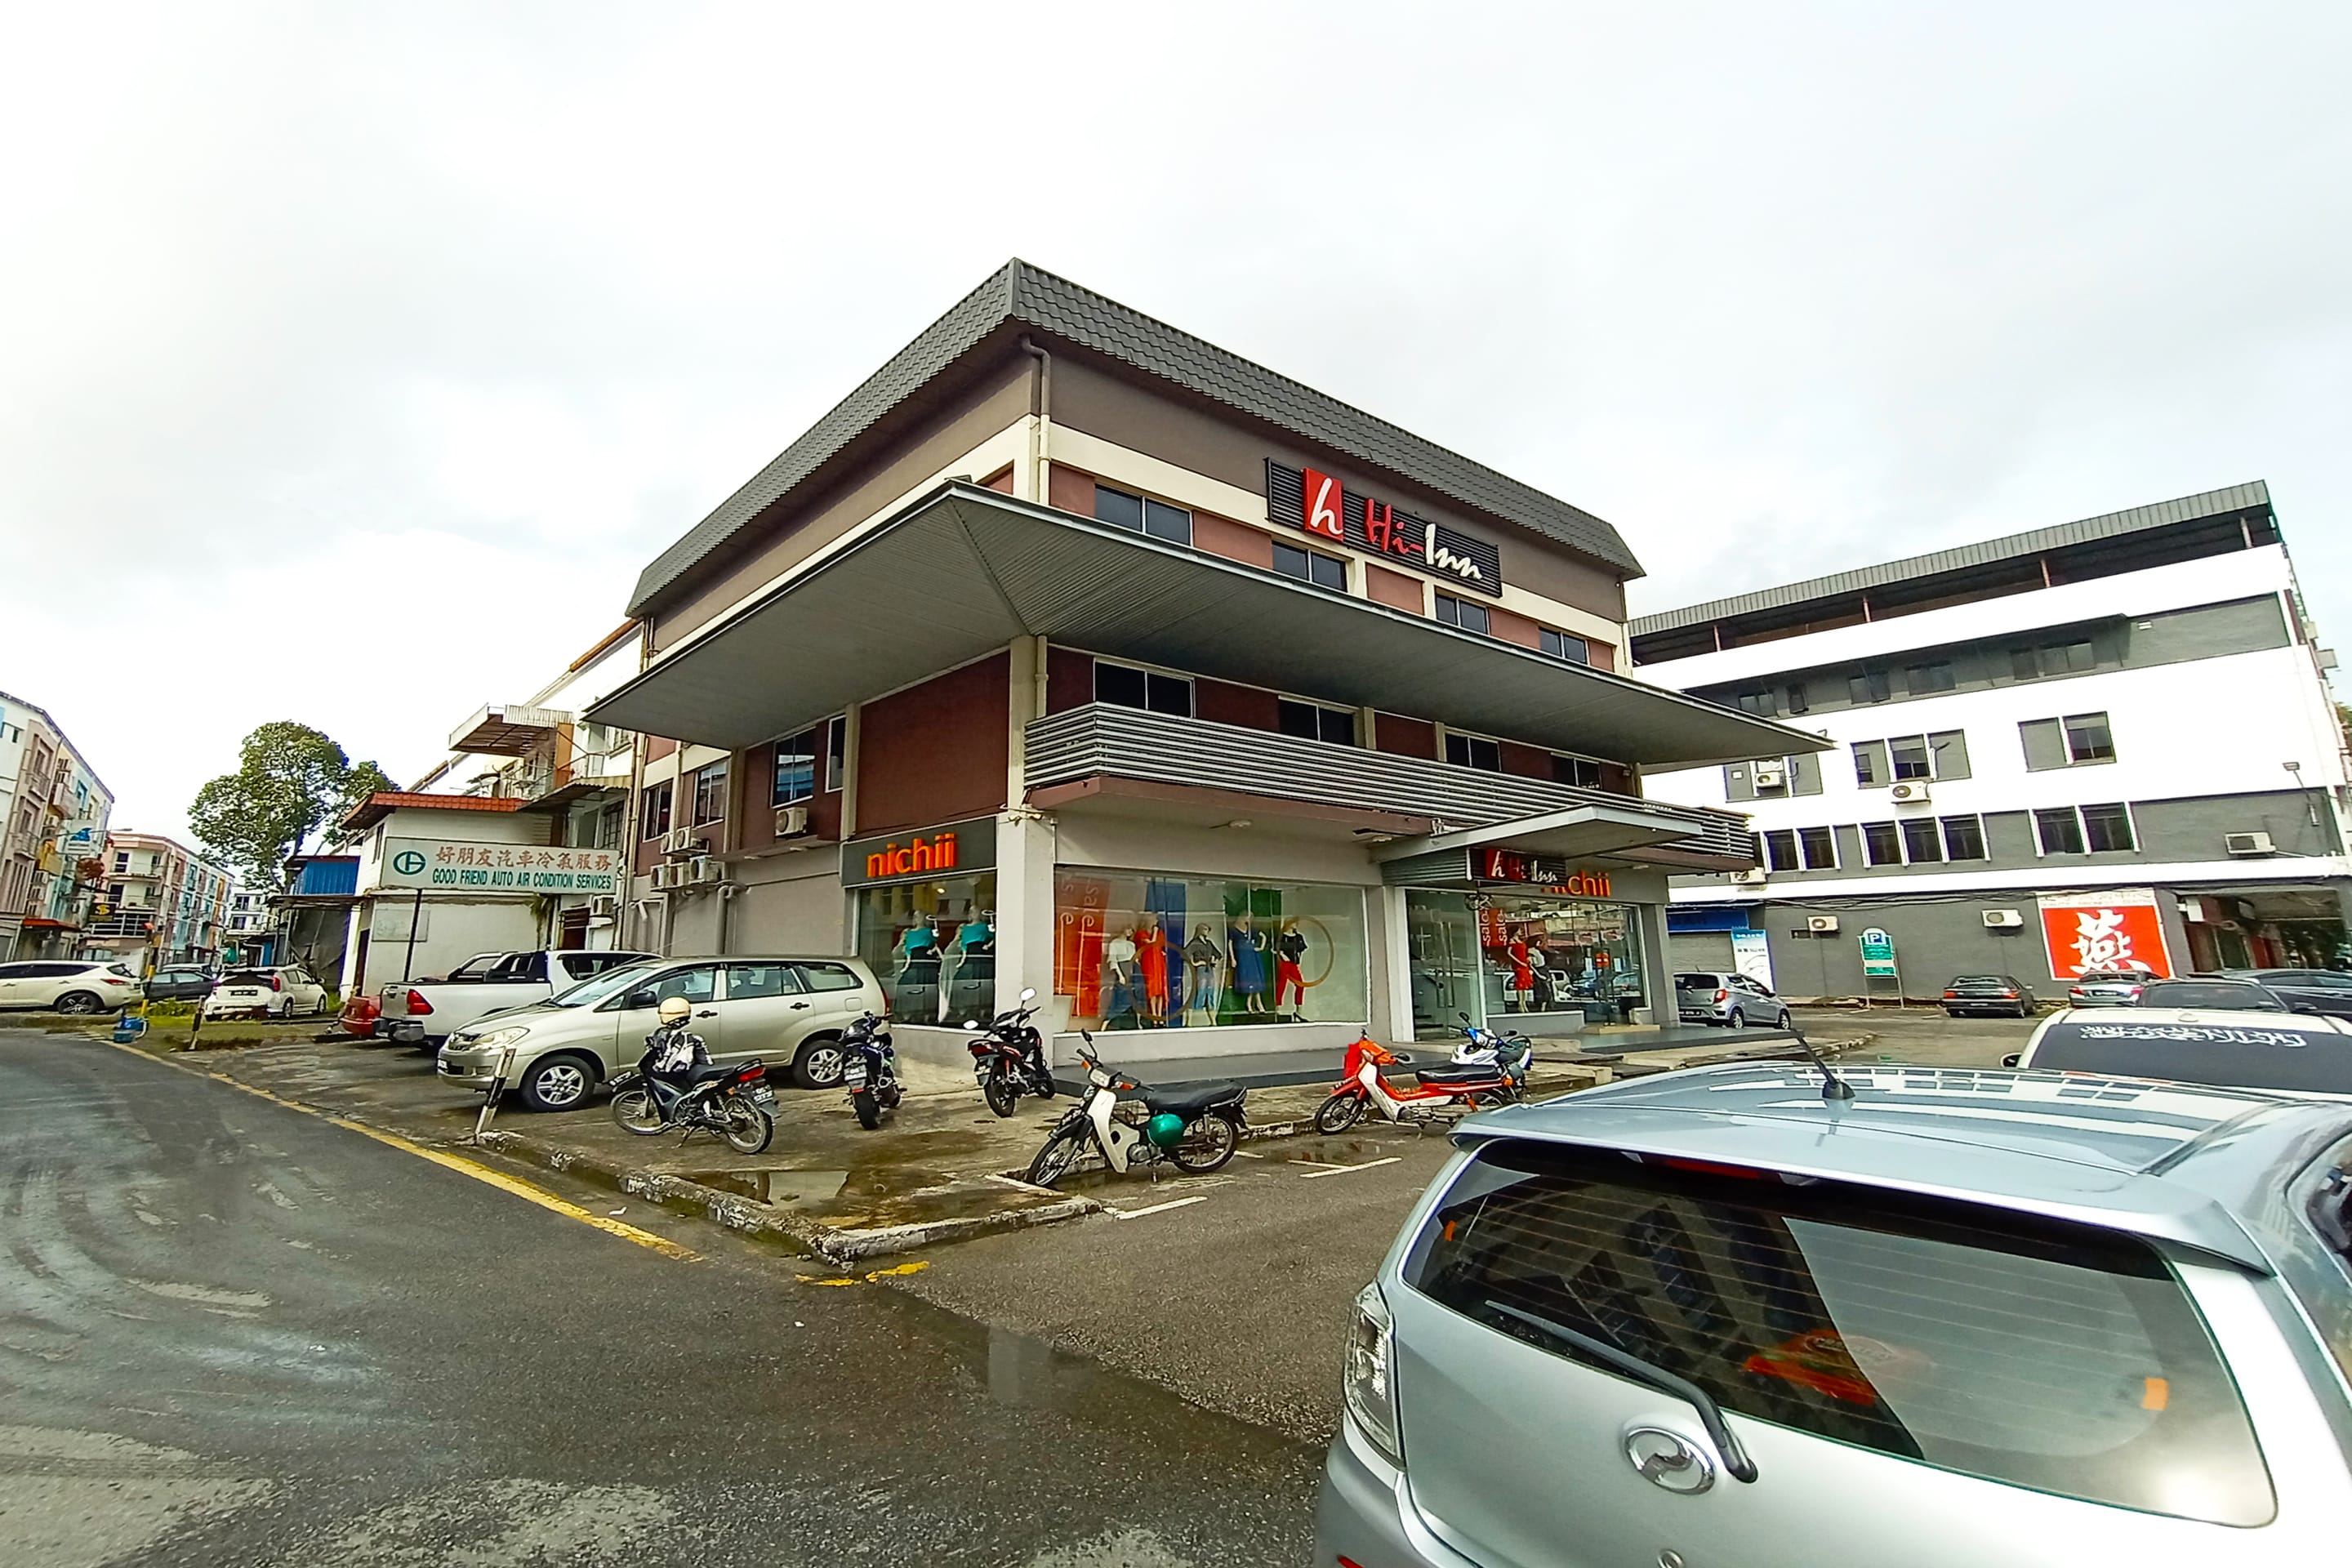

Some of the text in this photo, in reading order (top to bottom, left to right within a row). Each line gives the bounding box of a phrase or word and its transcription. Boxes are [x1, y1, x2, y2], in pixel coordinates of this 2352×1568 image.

[1364, 497, 1483, 581] Hi-Inn
[435, 846, 612, 872] 好朋友汽車冷氣服務
[866, 833, 956, 878] nichii
[432, 868, 612, 889] GOOD FRIEND AUTO AIR CONDITION SERVICES
[1541, 870, 1612, 898] chii
[1869, 933, 1881, 943] P
[2069, 909, 2153, 975] 燕
